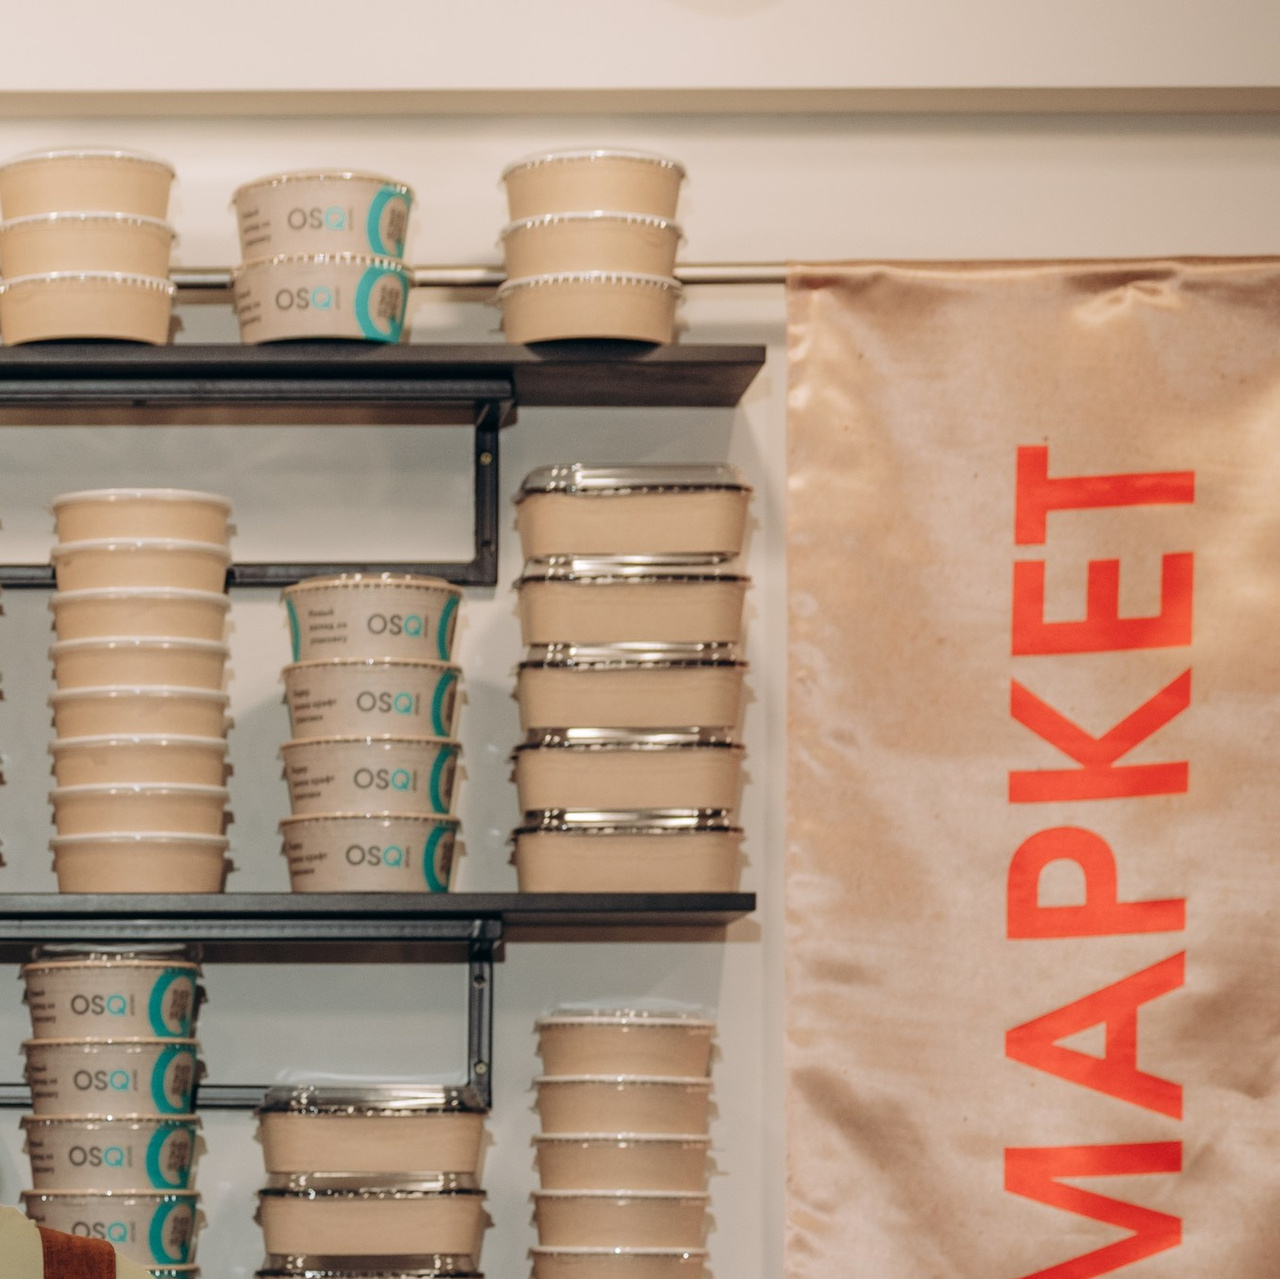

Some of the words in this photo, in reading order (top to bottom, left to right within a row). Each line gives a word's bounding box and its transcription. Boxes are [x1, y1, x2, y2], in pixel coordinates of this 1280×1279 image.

[287, 206, 346, 231] OSQ
[275, 286, 333, 310] OSQ
[367, 613, 422, 638] OSQ
[356, 691, 413, 716] OSQ
[353, 768, 411, 792] OSQ
[345, 845, 402, 868] OSQ
[71, 994, 126, 1016] OSQ
[74, 1069, 129, 1091] OSQ
[69, 1146, 124, 1167] OSQ
